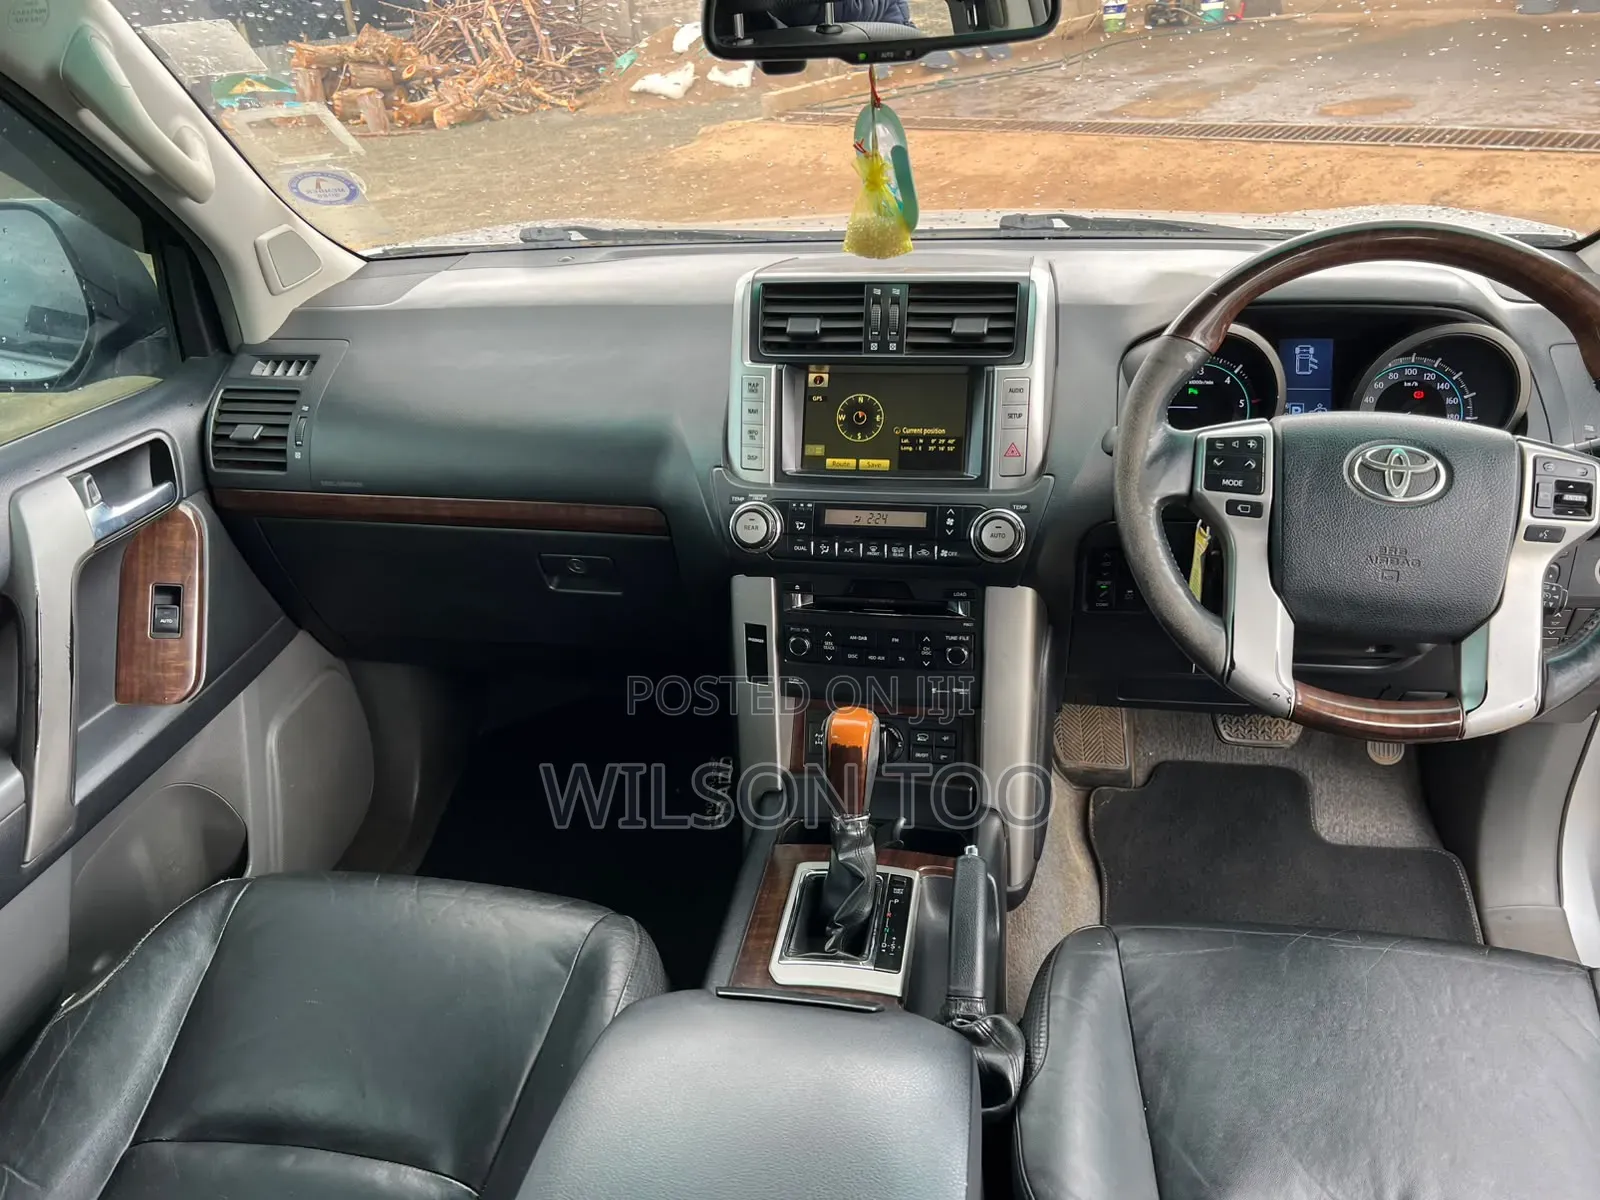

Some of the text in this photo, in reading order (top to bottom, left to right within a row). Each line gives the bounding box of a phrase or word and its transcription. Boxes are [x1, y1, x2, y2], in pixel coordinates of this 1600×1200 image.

[1224, 376, 1231, 384] 4
[902, 426, 946, 436] Current position
[1222, 478, 1243, 487] MODE
